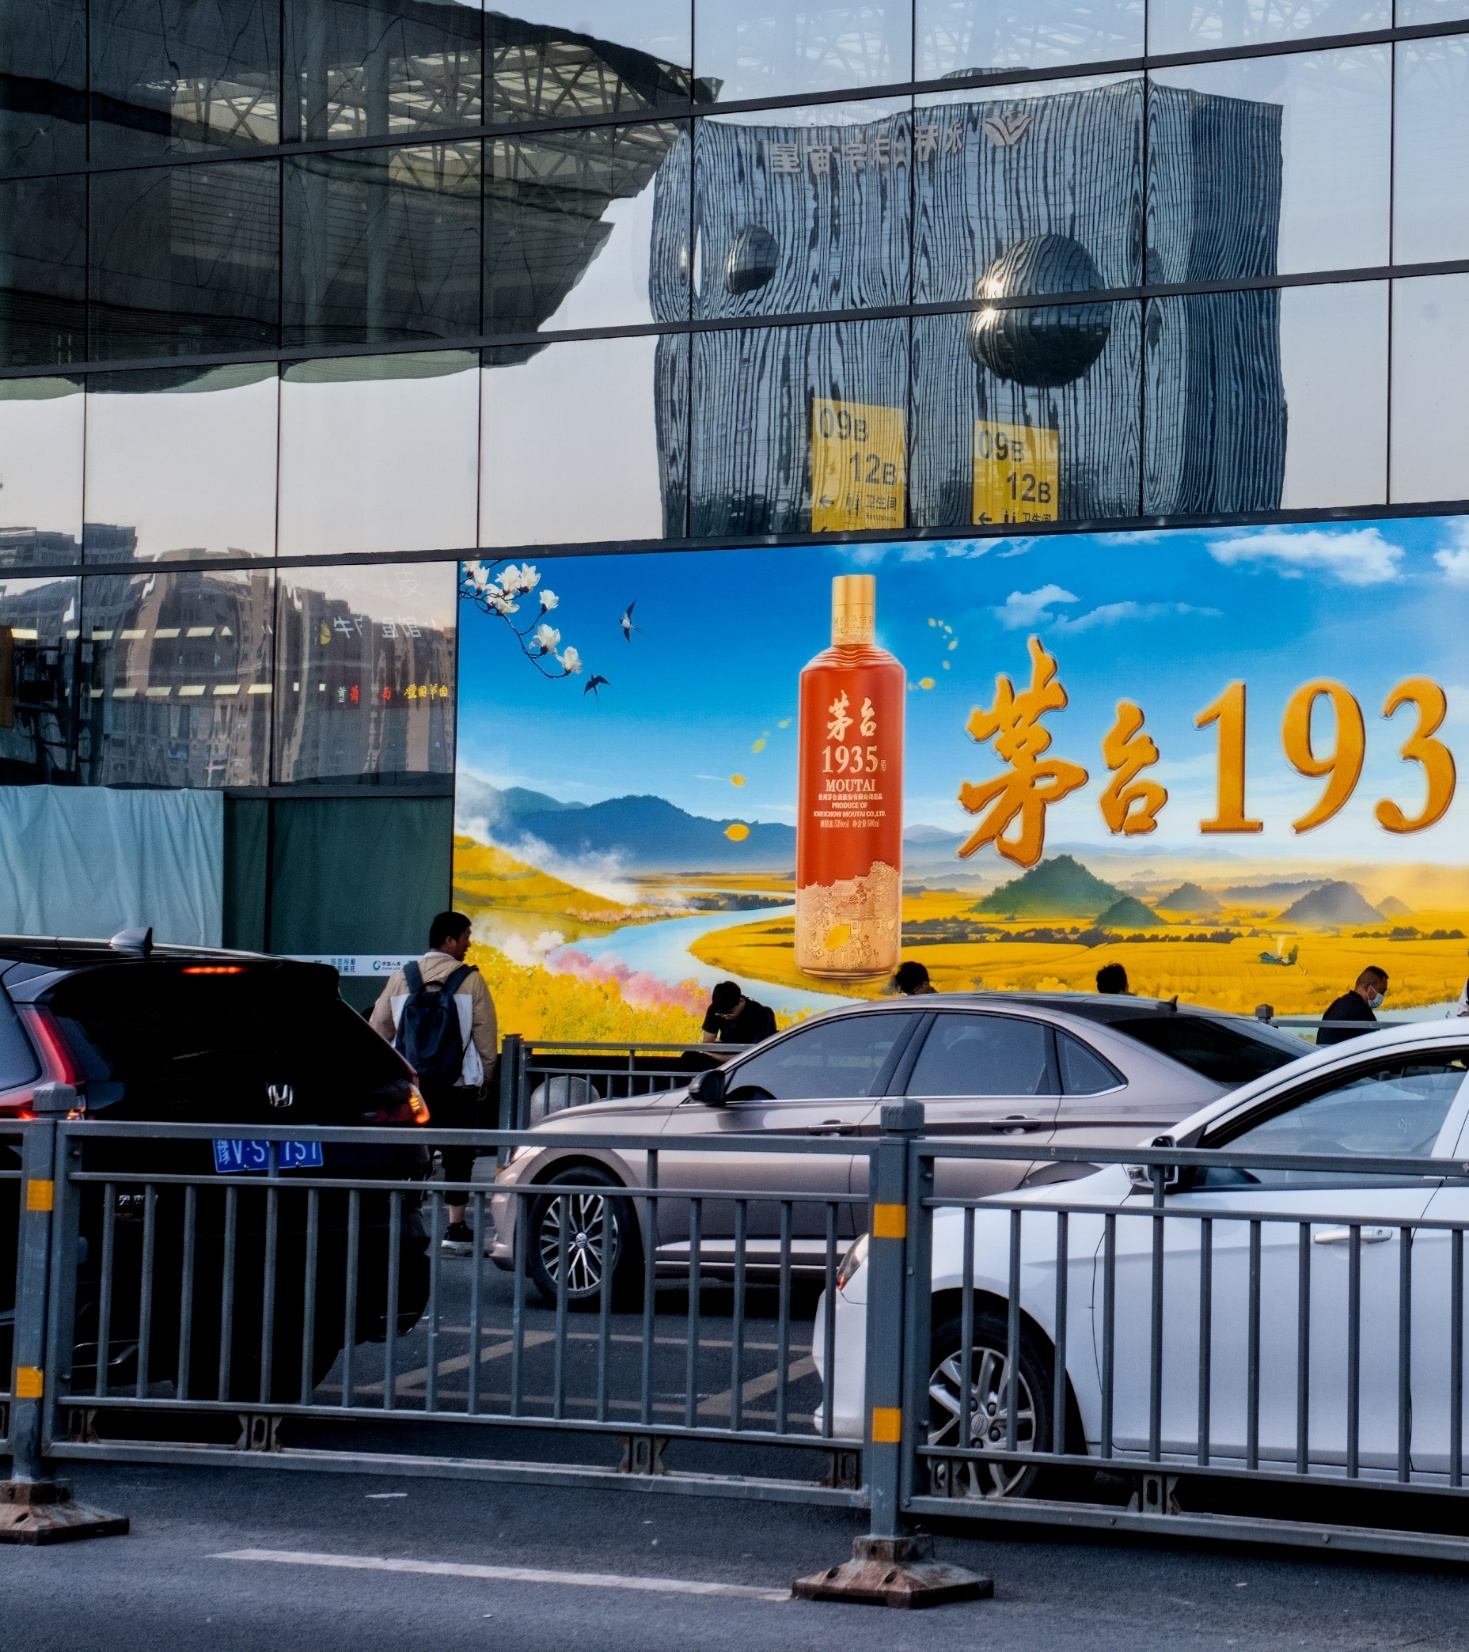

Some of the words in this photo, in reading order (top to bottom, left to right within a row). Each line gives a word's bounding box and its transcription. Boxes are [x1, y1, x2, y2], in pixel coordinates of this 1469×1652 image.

[819, 407, 869, 442] 09B
[978, 429, 1025, 463] 09B
[849, 452, 897, 486] 12B
[1006, 472, 1052, 504] 12B
[826, 689, 877, 743] 茅台
[821, 745, 879, 774] 1935
[825, 779, 876, 792] MOUTAI
